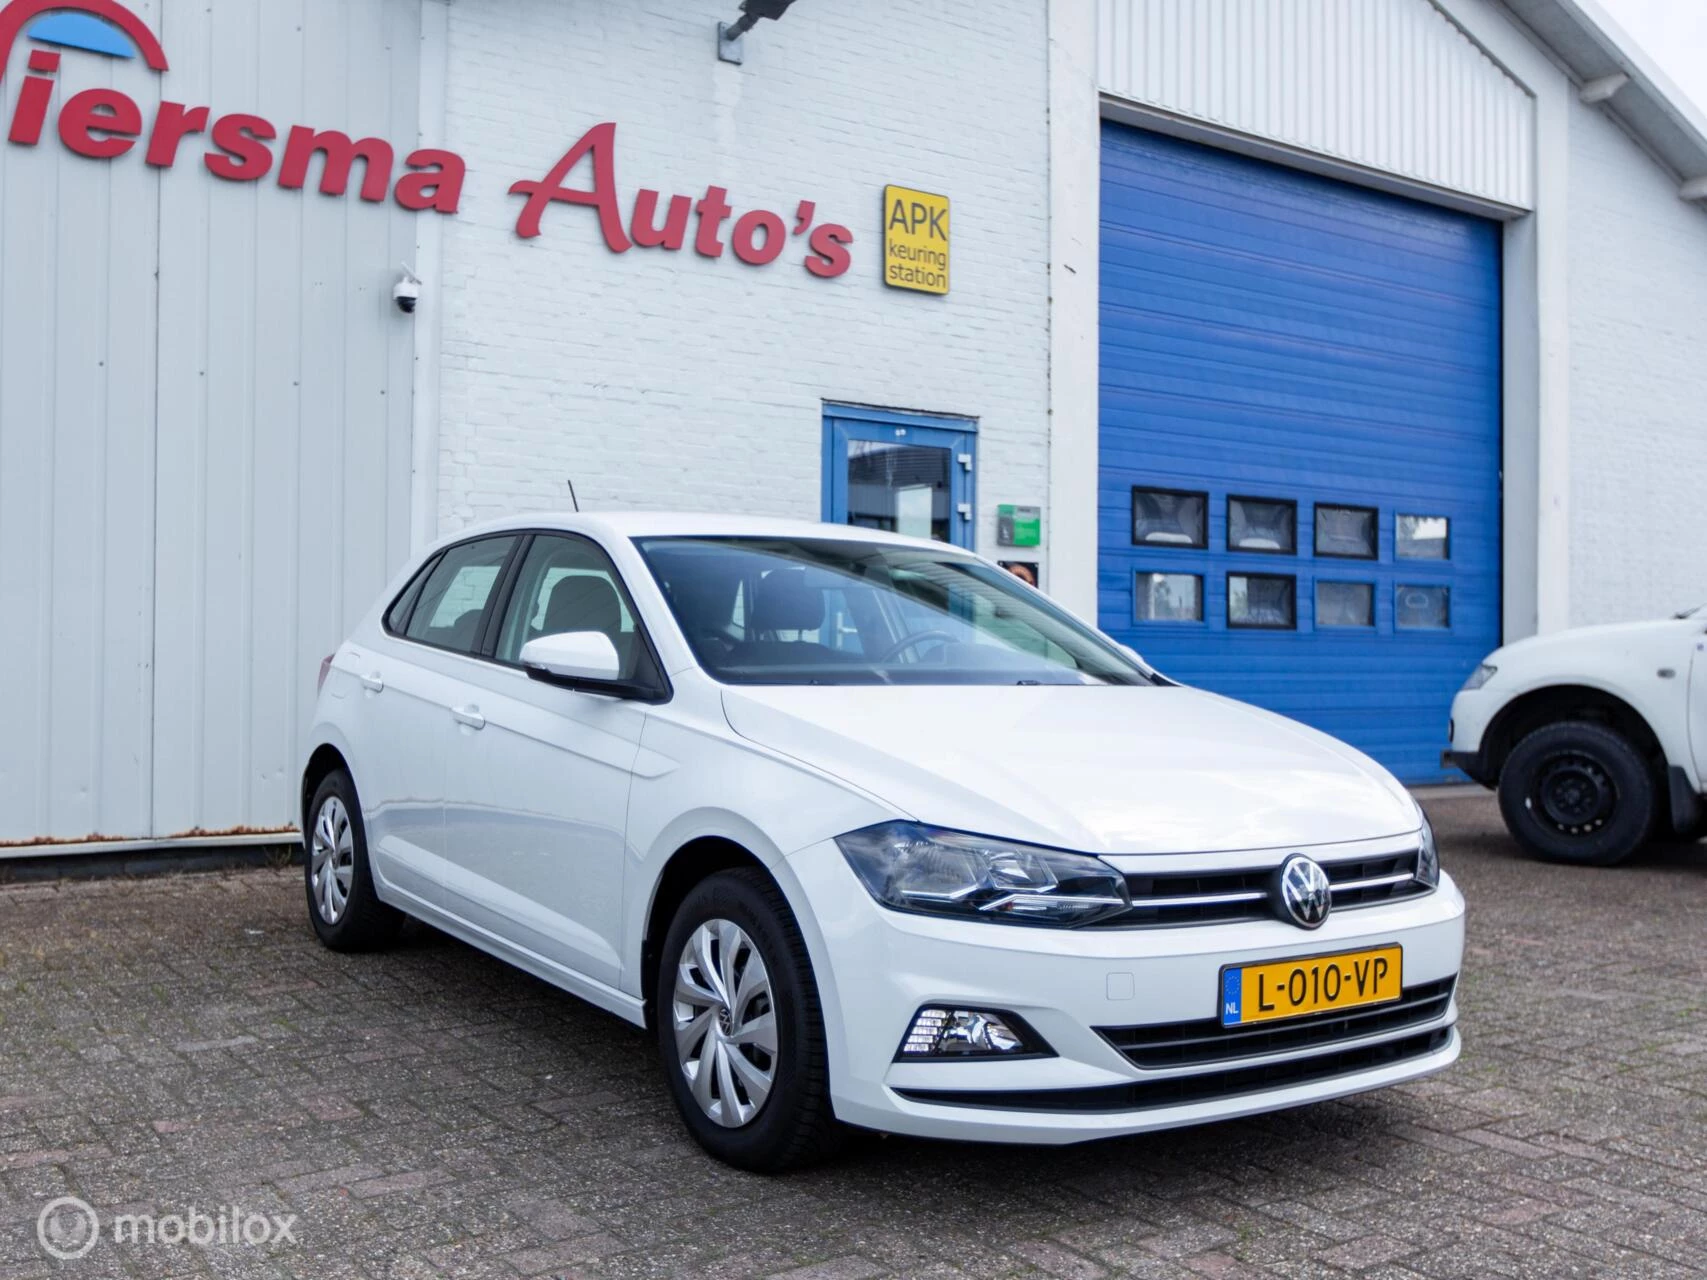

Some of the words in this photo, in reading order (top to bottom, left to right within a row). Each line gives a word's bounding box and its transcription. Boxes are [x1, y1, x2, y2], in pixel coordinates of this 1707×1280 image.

[7, 49, 466, 215] iersma
[508, 122, 854, 278] Auto's
[888, 198, 948, 241] APK
[888, 238, 947, 271] keuring
[889, 263, 947, 289] station
[1258, 957, 1388, 1012] L-010-VP
[1225, 1002, 1239, 1015] NL
